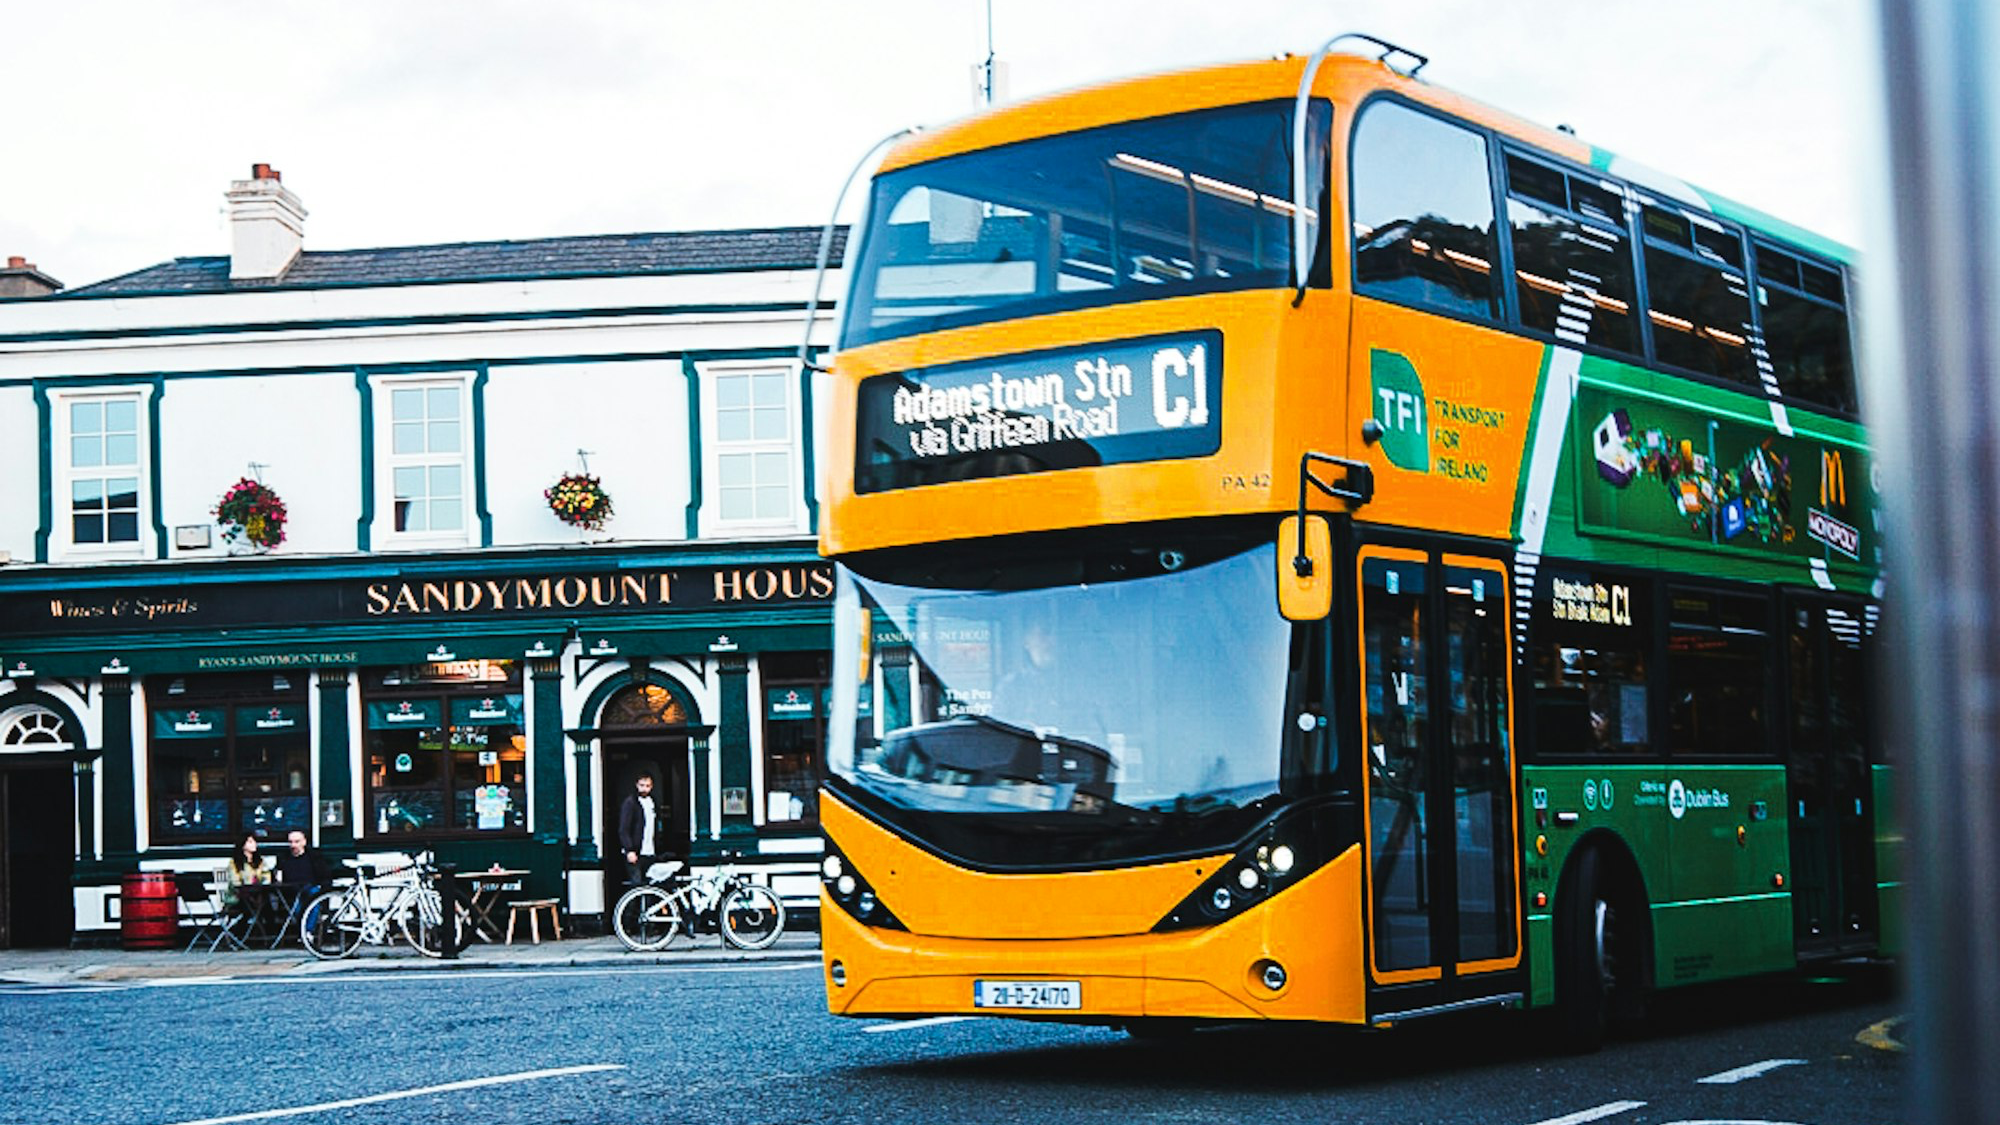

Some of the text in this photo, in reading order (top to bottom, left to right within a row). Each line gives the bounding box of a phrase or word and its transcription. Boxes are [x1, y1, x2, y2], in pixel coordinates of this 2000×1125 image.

[893, 357, 1133, 425] Adamstown Stn
[1151, 344, 1209, 429] C1
[1377, 387, 1422, 435] TFI
[1435, 399, 1505, 429] TRANSPORT
[909, 420, 949, 457] via
[1052, 397, 1119, 440] Road
[1435, 428, 1460, 449] FOR
[1222, 476, 1246, 491] PA
[1436, 457, 1488, 482] IRELAND
[1808, 509, 1858, 553] MONOPOLY
[366, 567, 835, 615] SANDYMOUNT HOUS
[1611, 584, 1632, 626] C1
[50, 599, 105, 617] Wines
[134, 596, 198, 620] Spirits
[198, 652, 359, 668] RYAN'S SANDYMOUNT HOUSE
[1711, 788, 1729, 807] Bus
[993, 987, 1070, 1005] 211-D-24170
